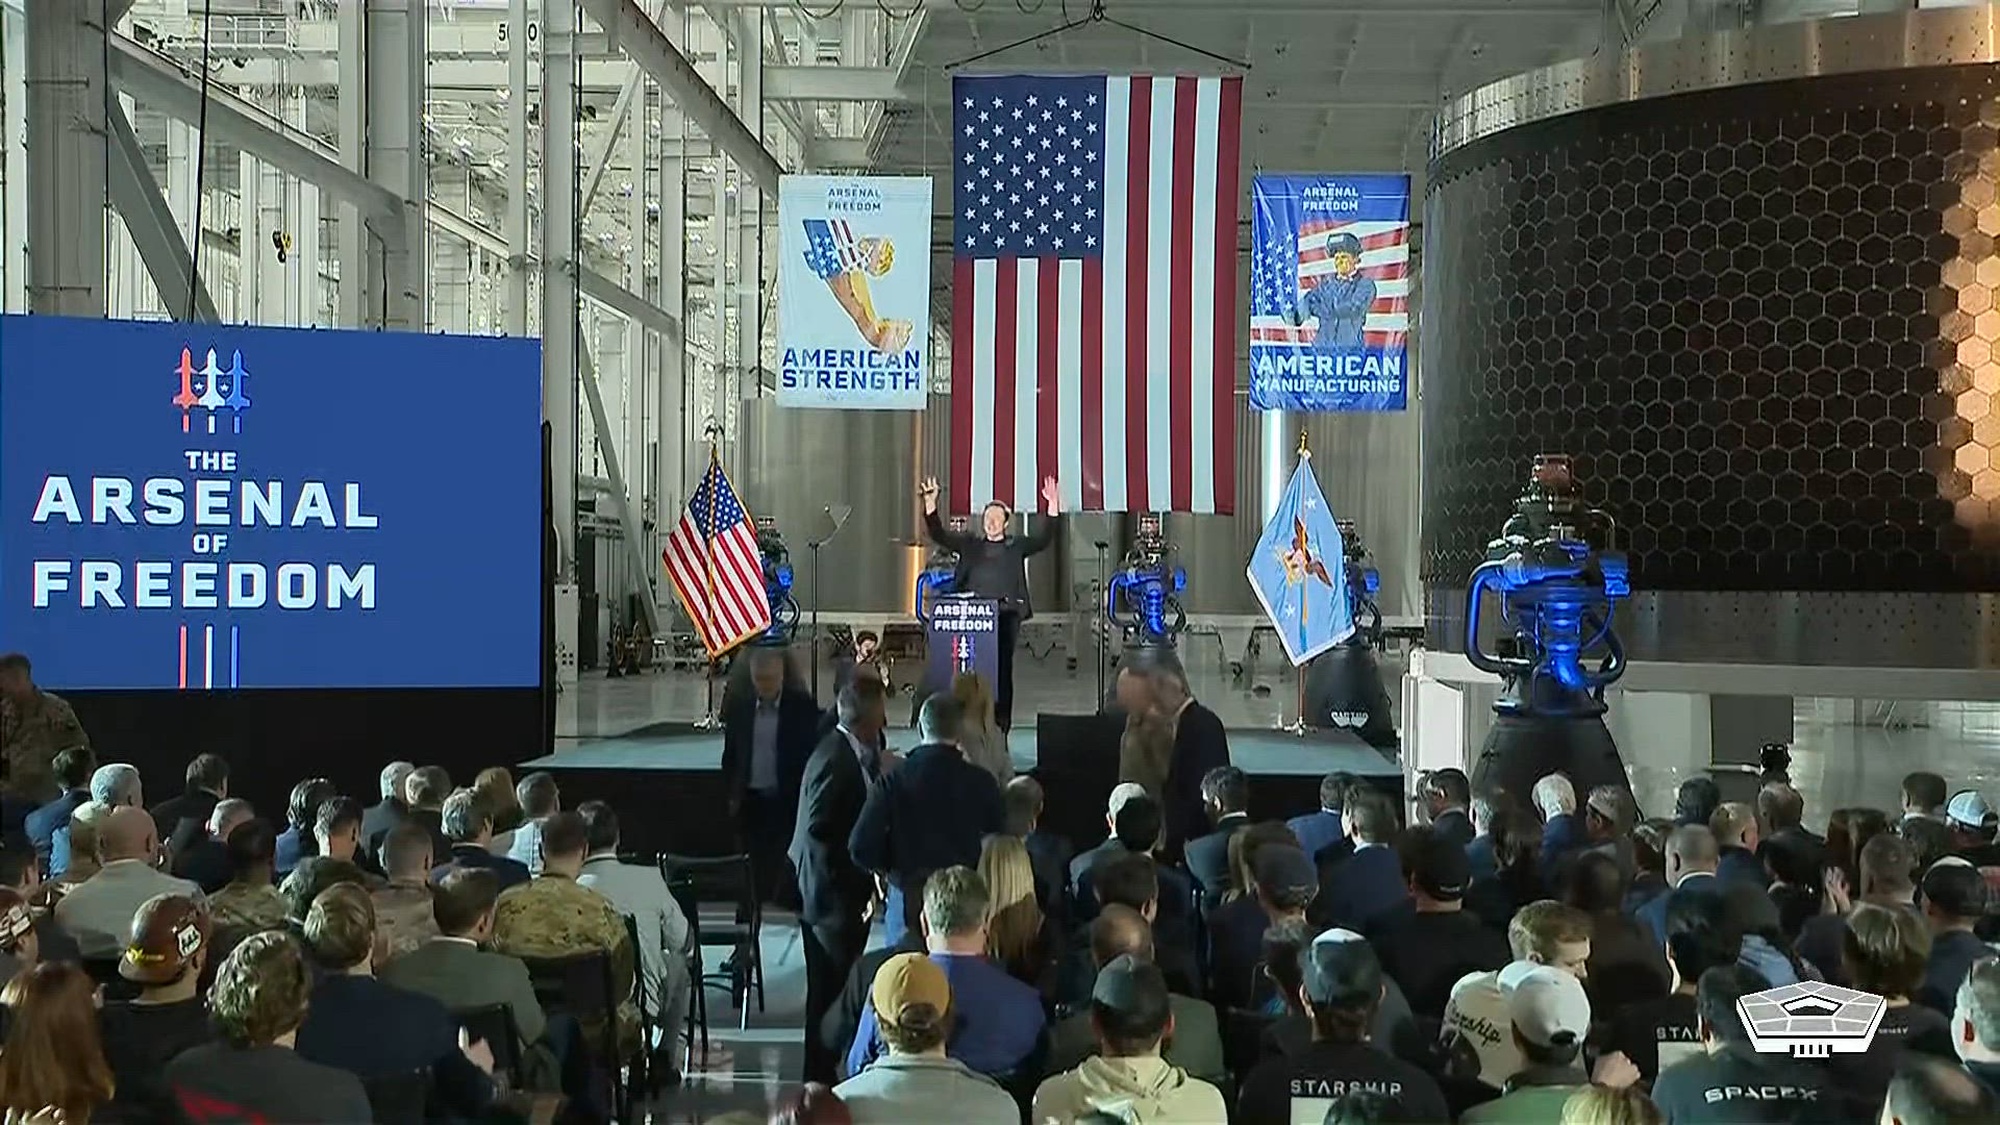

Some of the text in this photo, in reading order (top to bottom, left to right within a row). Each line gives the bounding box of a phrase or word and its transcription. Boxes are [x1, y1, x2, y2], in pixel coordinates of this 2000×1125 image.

[828, 188, 881, 198] ARSENAL
[1303, 187, 1359, 197] ARSENAL
[828, 202, 881, 211] FREEDOM
[1303, 202, 1359, 211] FREEDOM
[782, 348, 920, 369] AMERICAN
[1256, 355, 1401, 376] AMERICAN
[782, 369, 920, 390] STRENGTH
[1255, 377, 1401, 393] MANUFACTURING
[184, 450, 237, 471] THE
[32, 475, 379, 528] ARSENAL
[192, 534, 228, 554] OF
[33, 560, 376, 609] FREEDOM
[934, 604, 994, 616] ARSENAL
[934, 620, 994, 631] FREEDOM
[1290, 1079, 1402, 1096] STARSHIP
[1704, 1085, 1818, 1104] SPACEX
